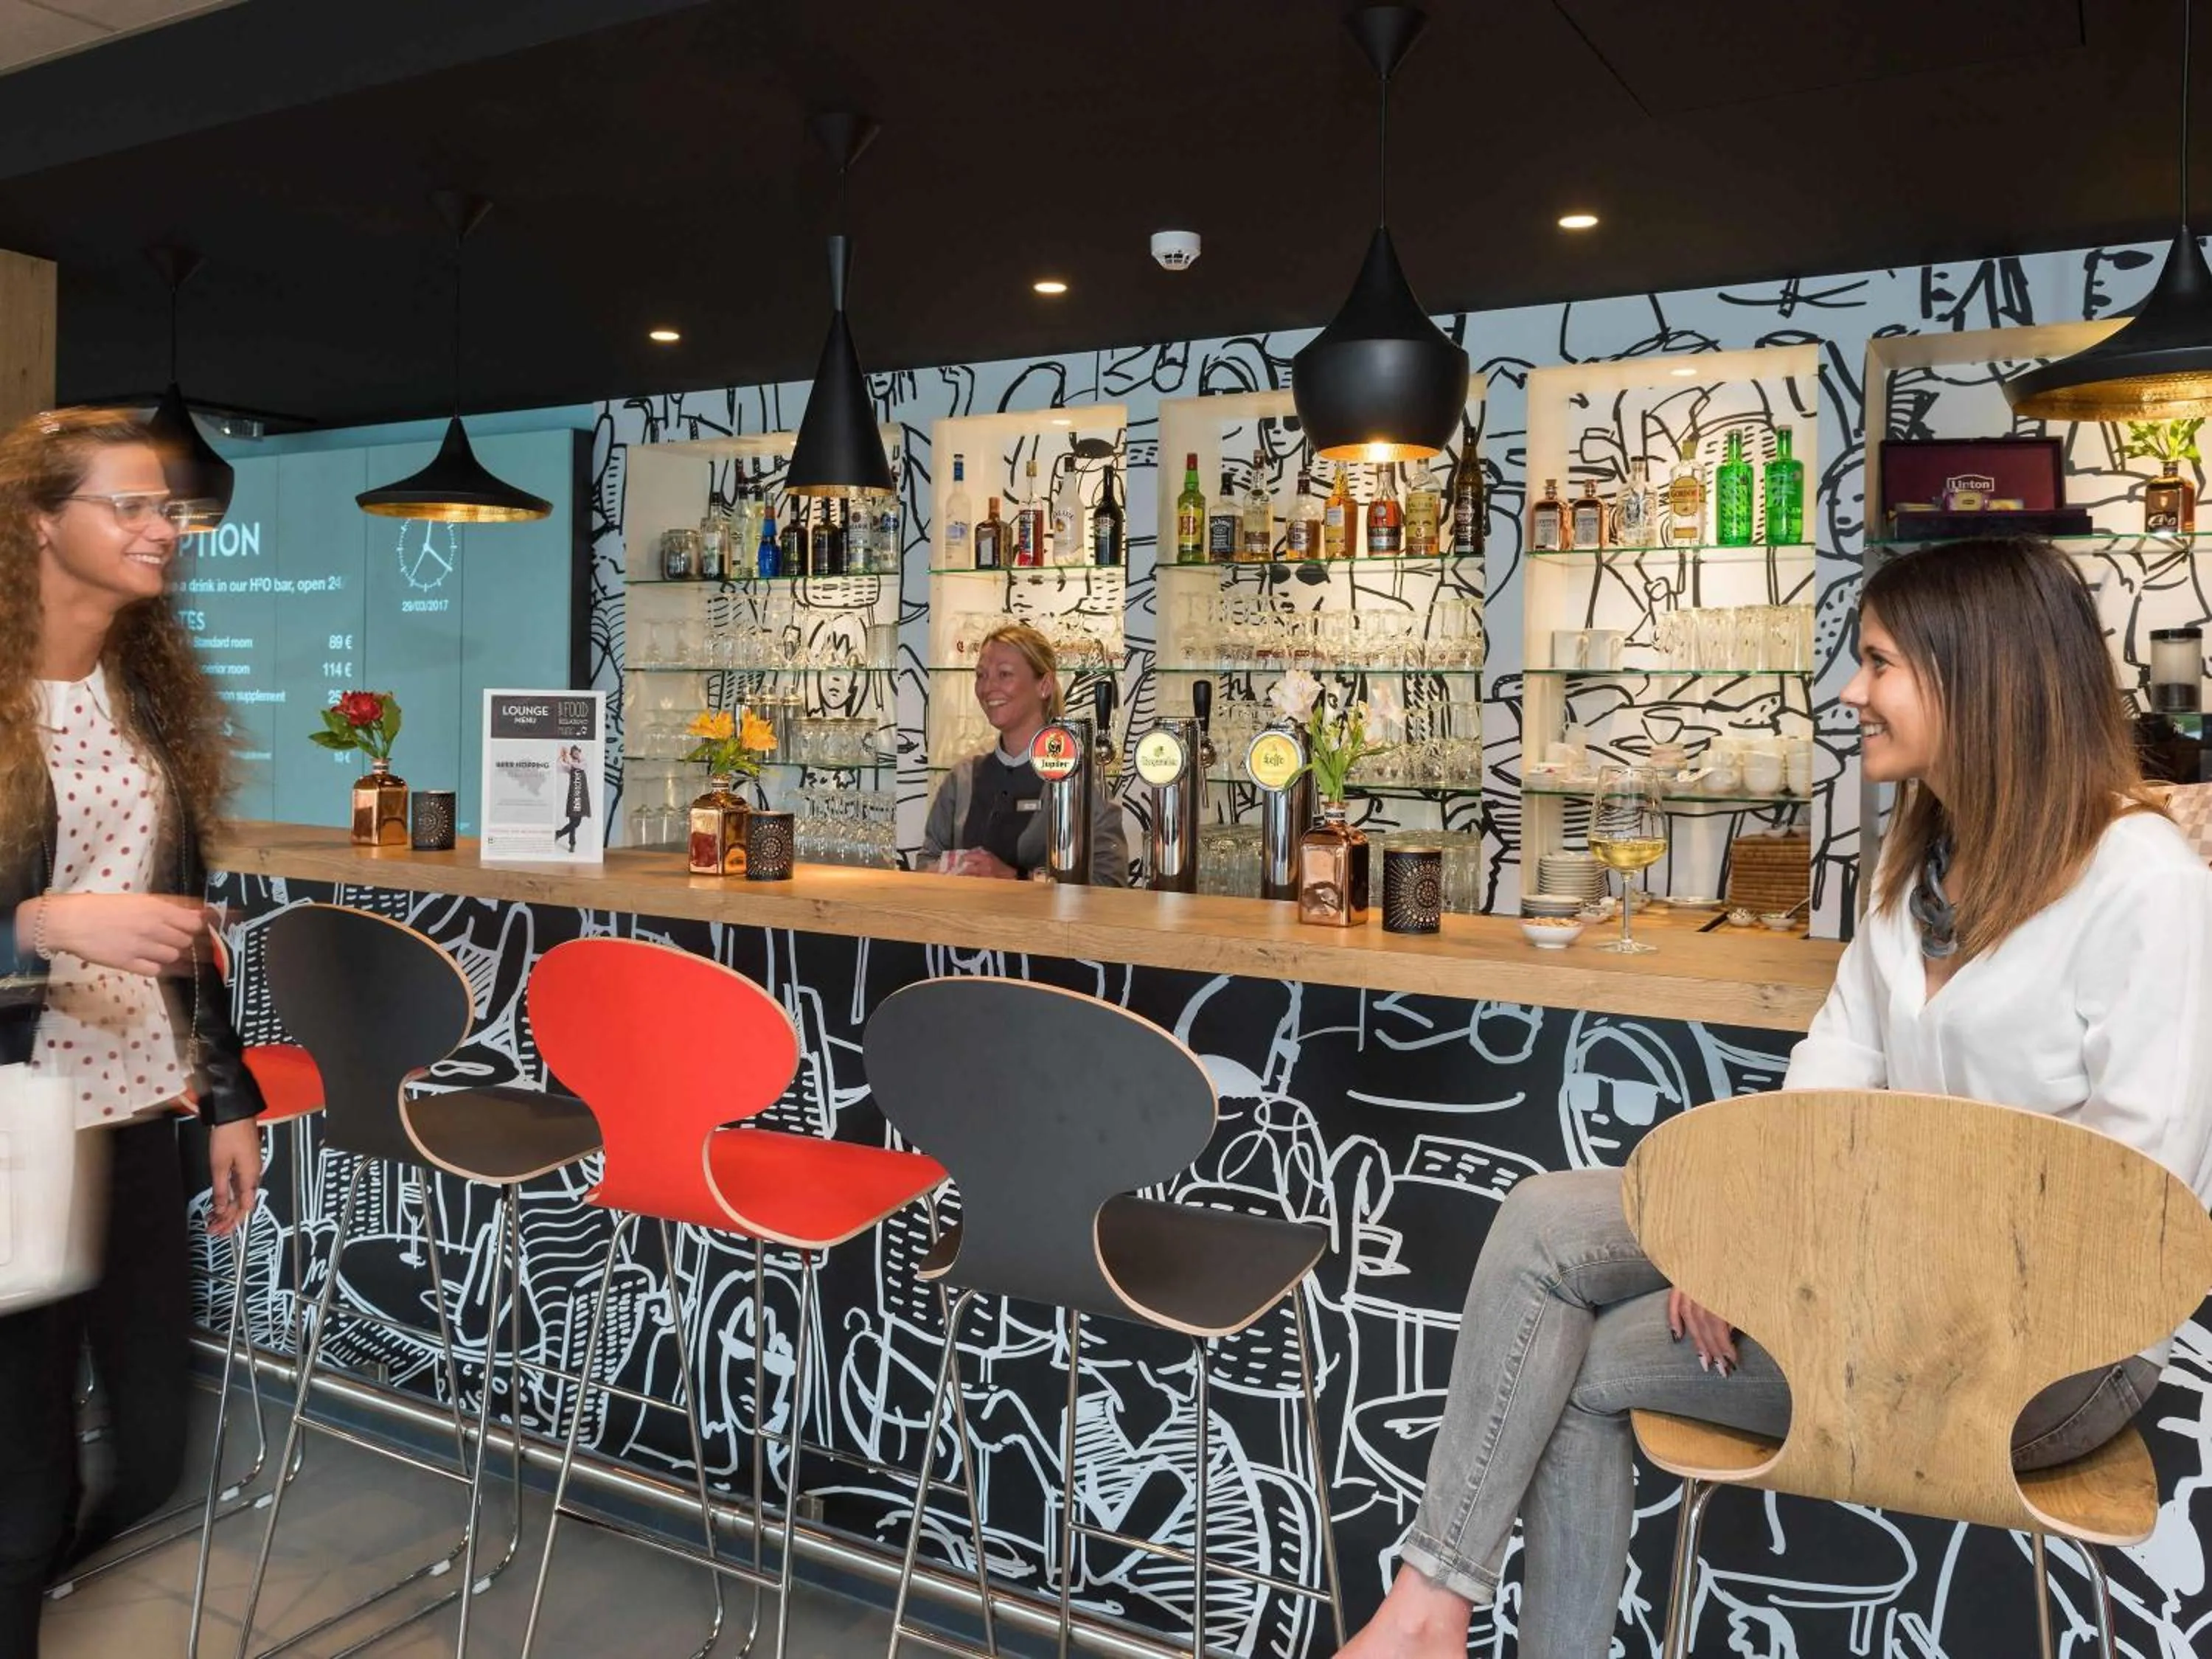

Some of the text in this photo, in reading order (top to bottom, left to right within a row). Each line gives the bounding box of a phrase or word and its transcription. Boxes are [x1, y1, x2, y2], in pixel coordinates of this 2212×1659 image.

[179, 522, 260, 557] PTION
[229, 581, 248, 592] our
[297, 579, 325, 594] open
[178, 611, 206, 630] TES
[322, 662, 341, 677] 114
[502, 706, 549, 716] LOUNGE
